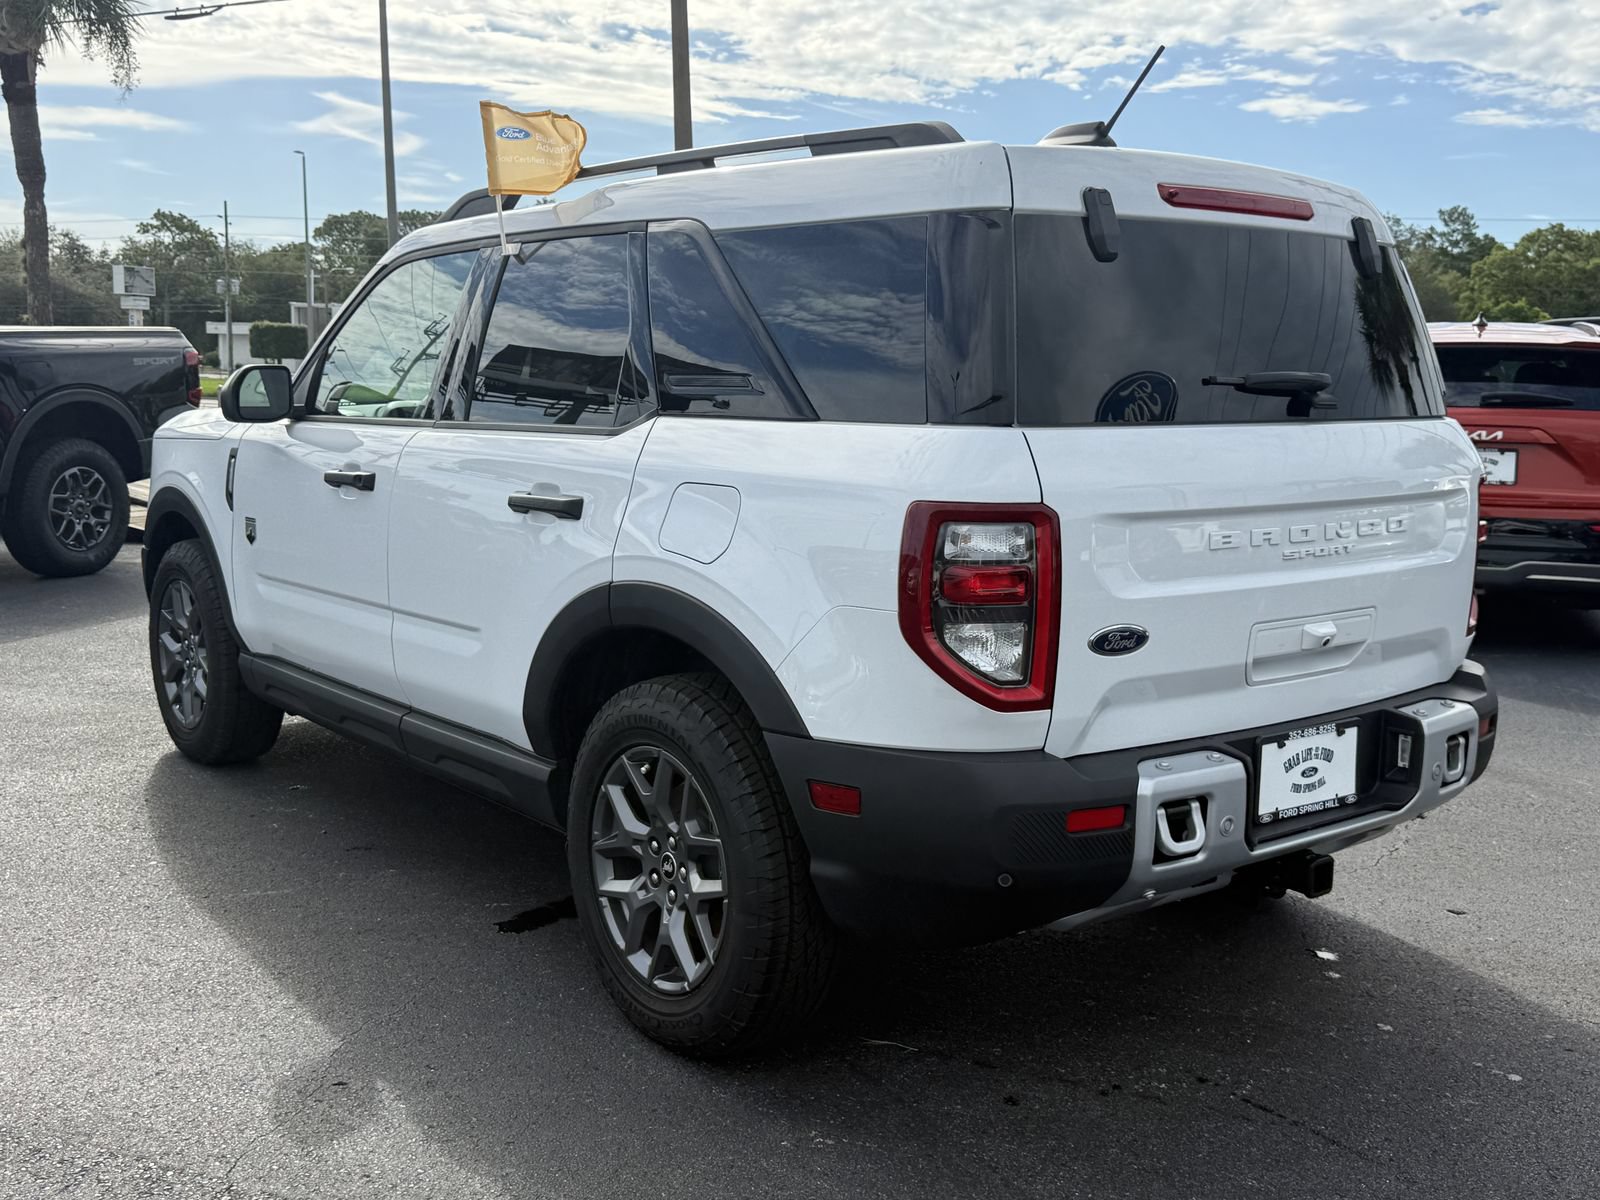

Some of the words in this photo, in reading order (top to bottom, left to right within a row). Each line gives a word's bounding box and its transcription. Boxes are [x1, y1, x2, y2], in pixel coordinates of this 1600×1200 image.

[501, 128, 525, 138] Ford
[133, 356, 177, 366] SPORT
[1208, 515, 1412, 550] BRONCO
[1282, 544, 1355, 560] SPORT
[1104, 631, 1138, 649] Ford
[1283, 753, 1301, 773] GRAB
[1301, 747, 1313, 763] LIFE
[1320, 747, 1334, 763] FORD
[1302, 781, 1317, 793] SPRING
[1317, 776, 1326, 789] HILL
[1279, 807, 1298, 819] FORD
[1299, 802, 1324, 815] SPRING
[1325, 799, 1340, 809] HILL
